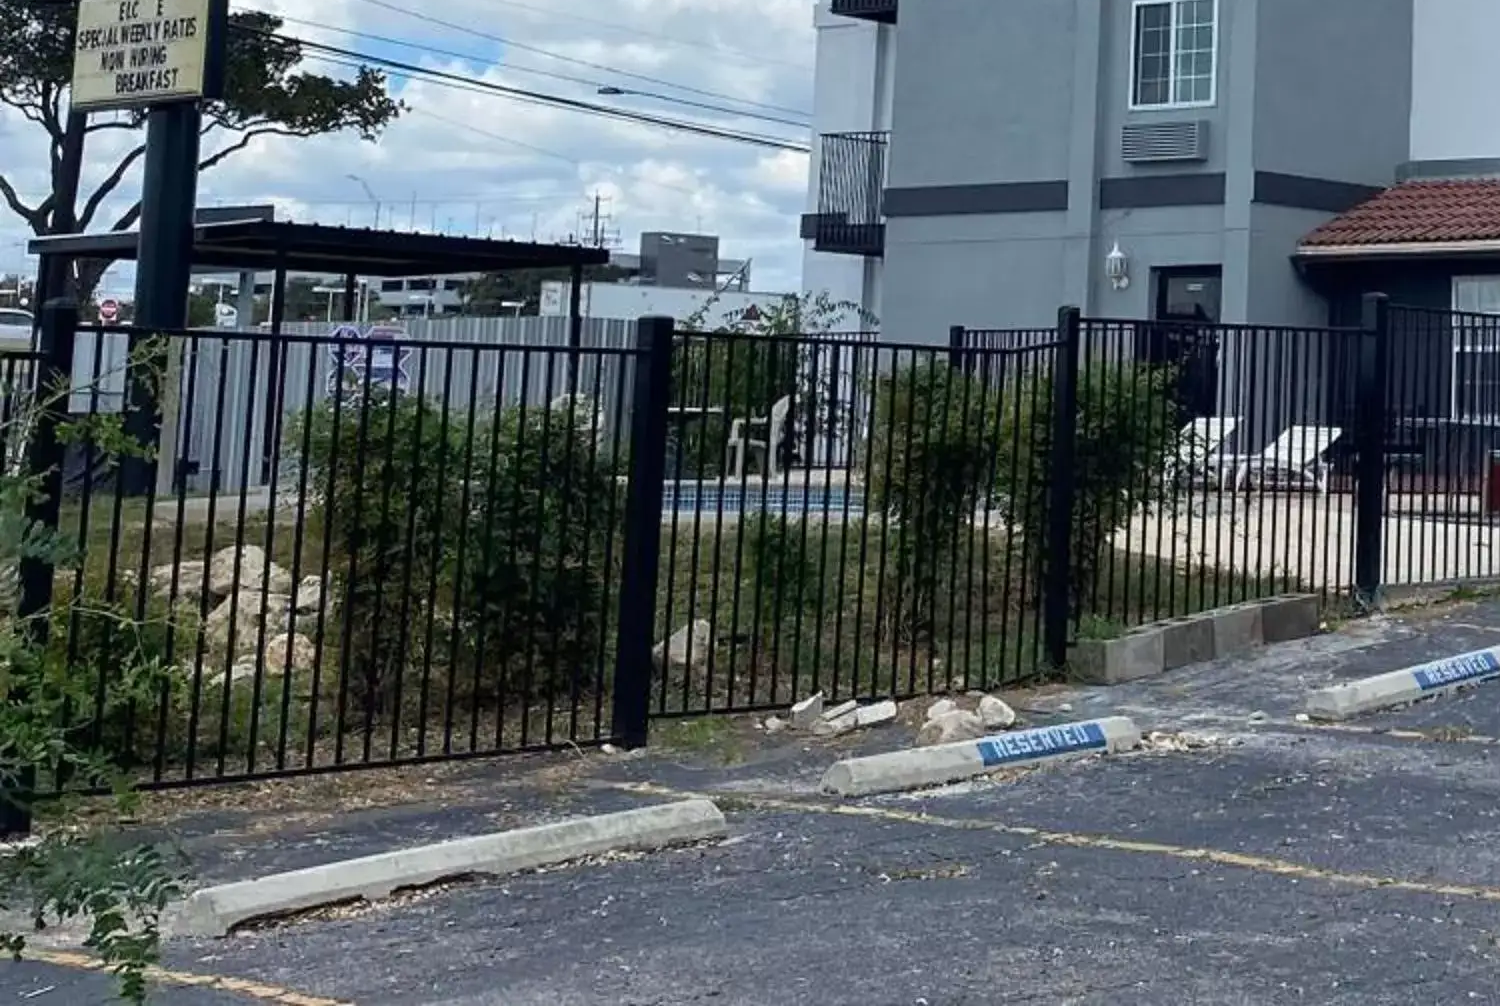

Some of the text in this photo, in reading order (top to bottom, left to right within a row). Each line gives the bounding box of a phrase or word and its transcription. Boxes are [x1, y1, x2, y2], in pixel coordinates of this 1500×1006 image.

[78, 26, 118, 50] SPECIAL
[121, 20, 161, 44] WEEKLY
[116, 68, 178, 93] BREAKFAST
[1424, 653, 1491, 683] RESERVED
[991, 725, 1090, 758] RESERVED
